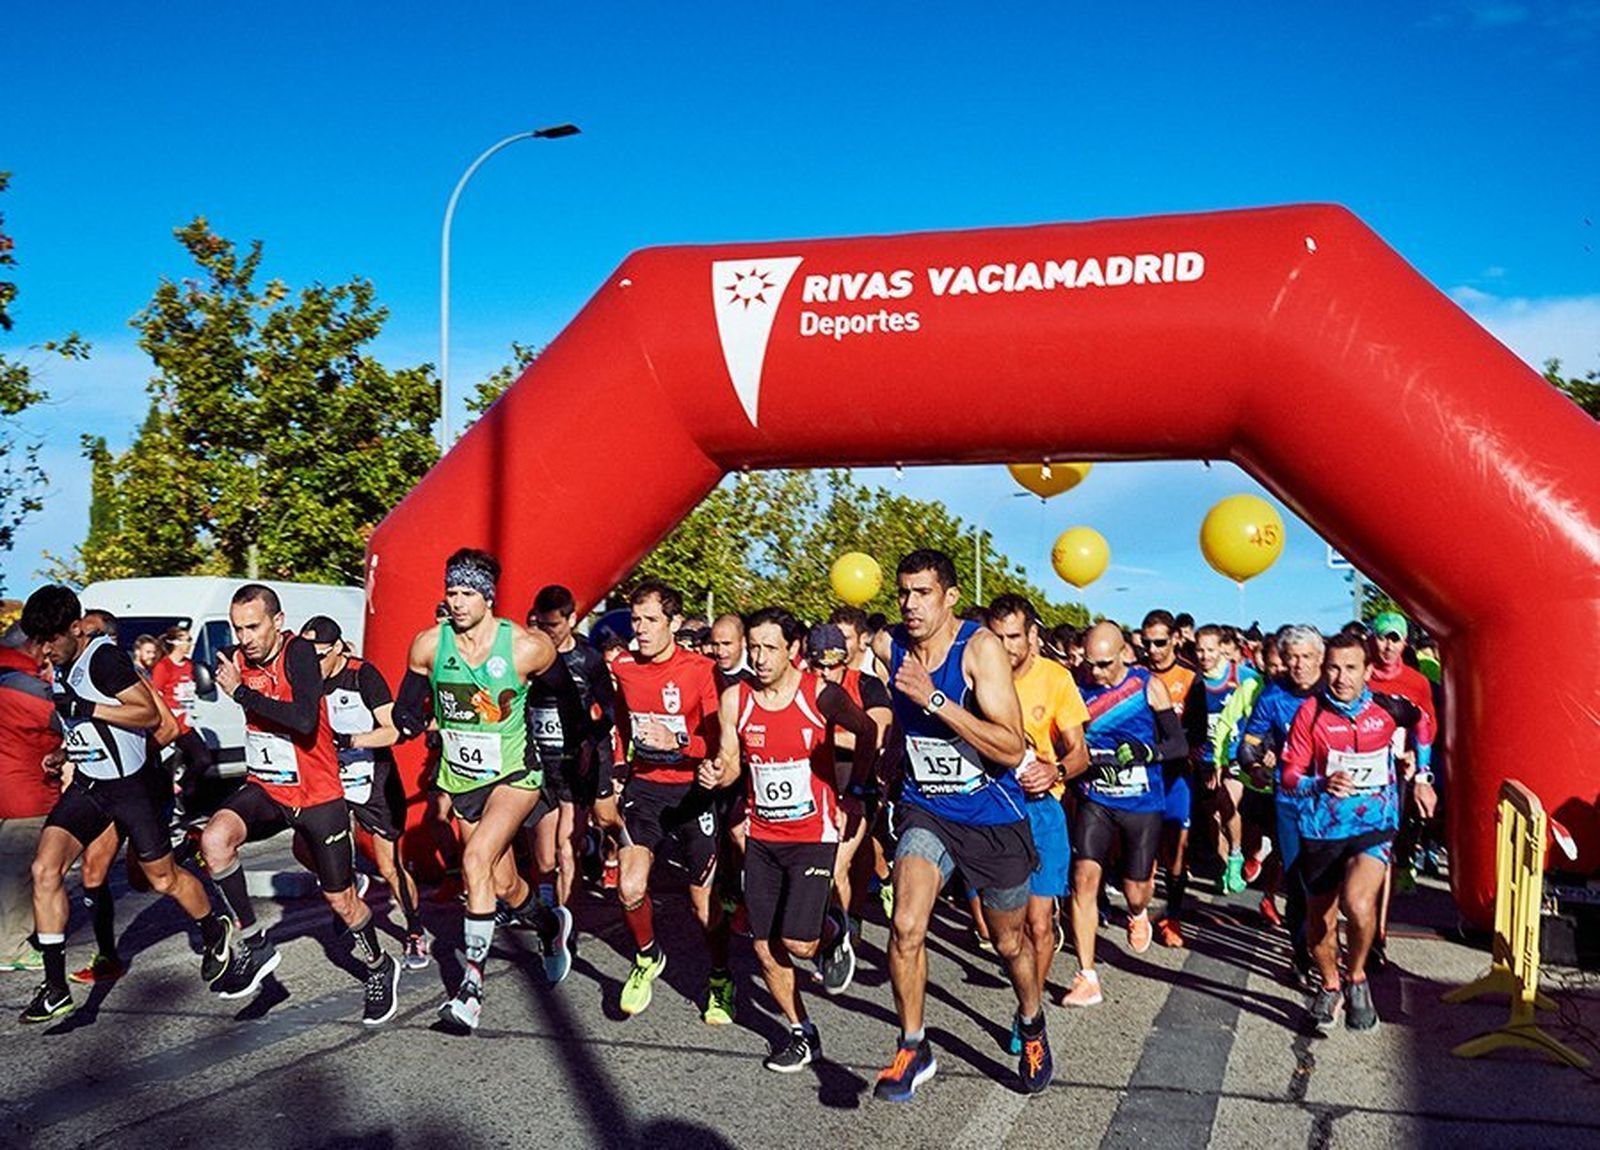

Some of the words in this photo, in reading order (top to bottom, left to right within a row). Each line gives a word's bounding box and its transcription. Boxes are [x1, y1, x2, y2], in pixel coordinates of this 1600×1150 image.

[802, 270, 914, 303] RIVAS
[927, 252, 1205, 296] VACIAMADRID
[800, 309, 920, 341] Deportes
[260, 747, 273, 765] 1
[459, 746, 484, 765] 64
[924, 756, 962, 776] 157
[765, 781, 793, 801] 69
